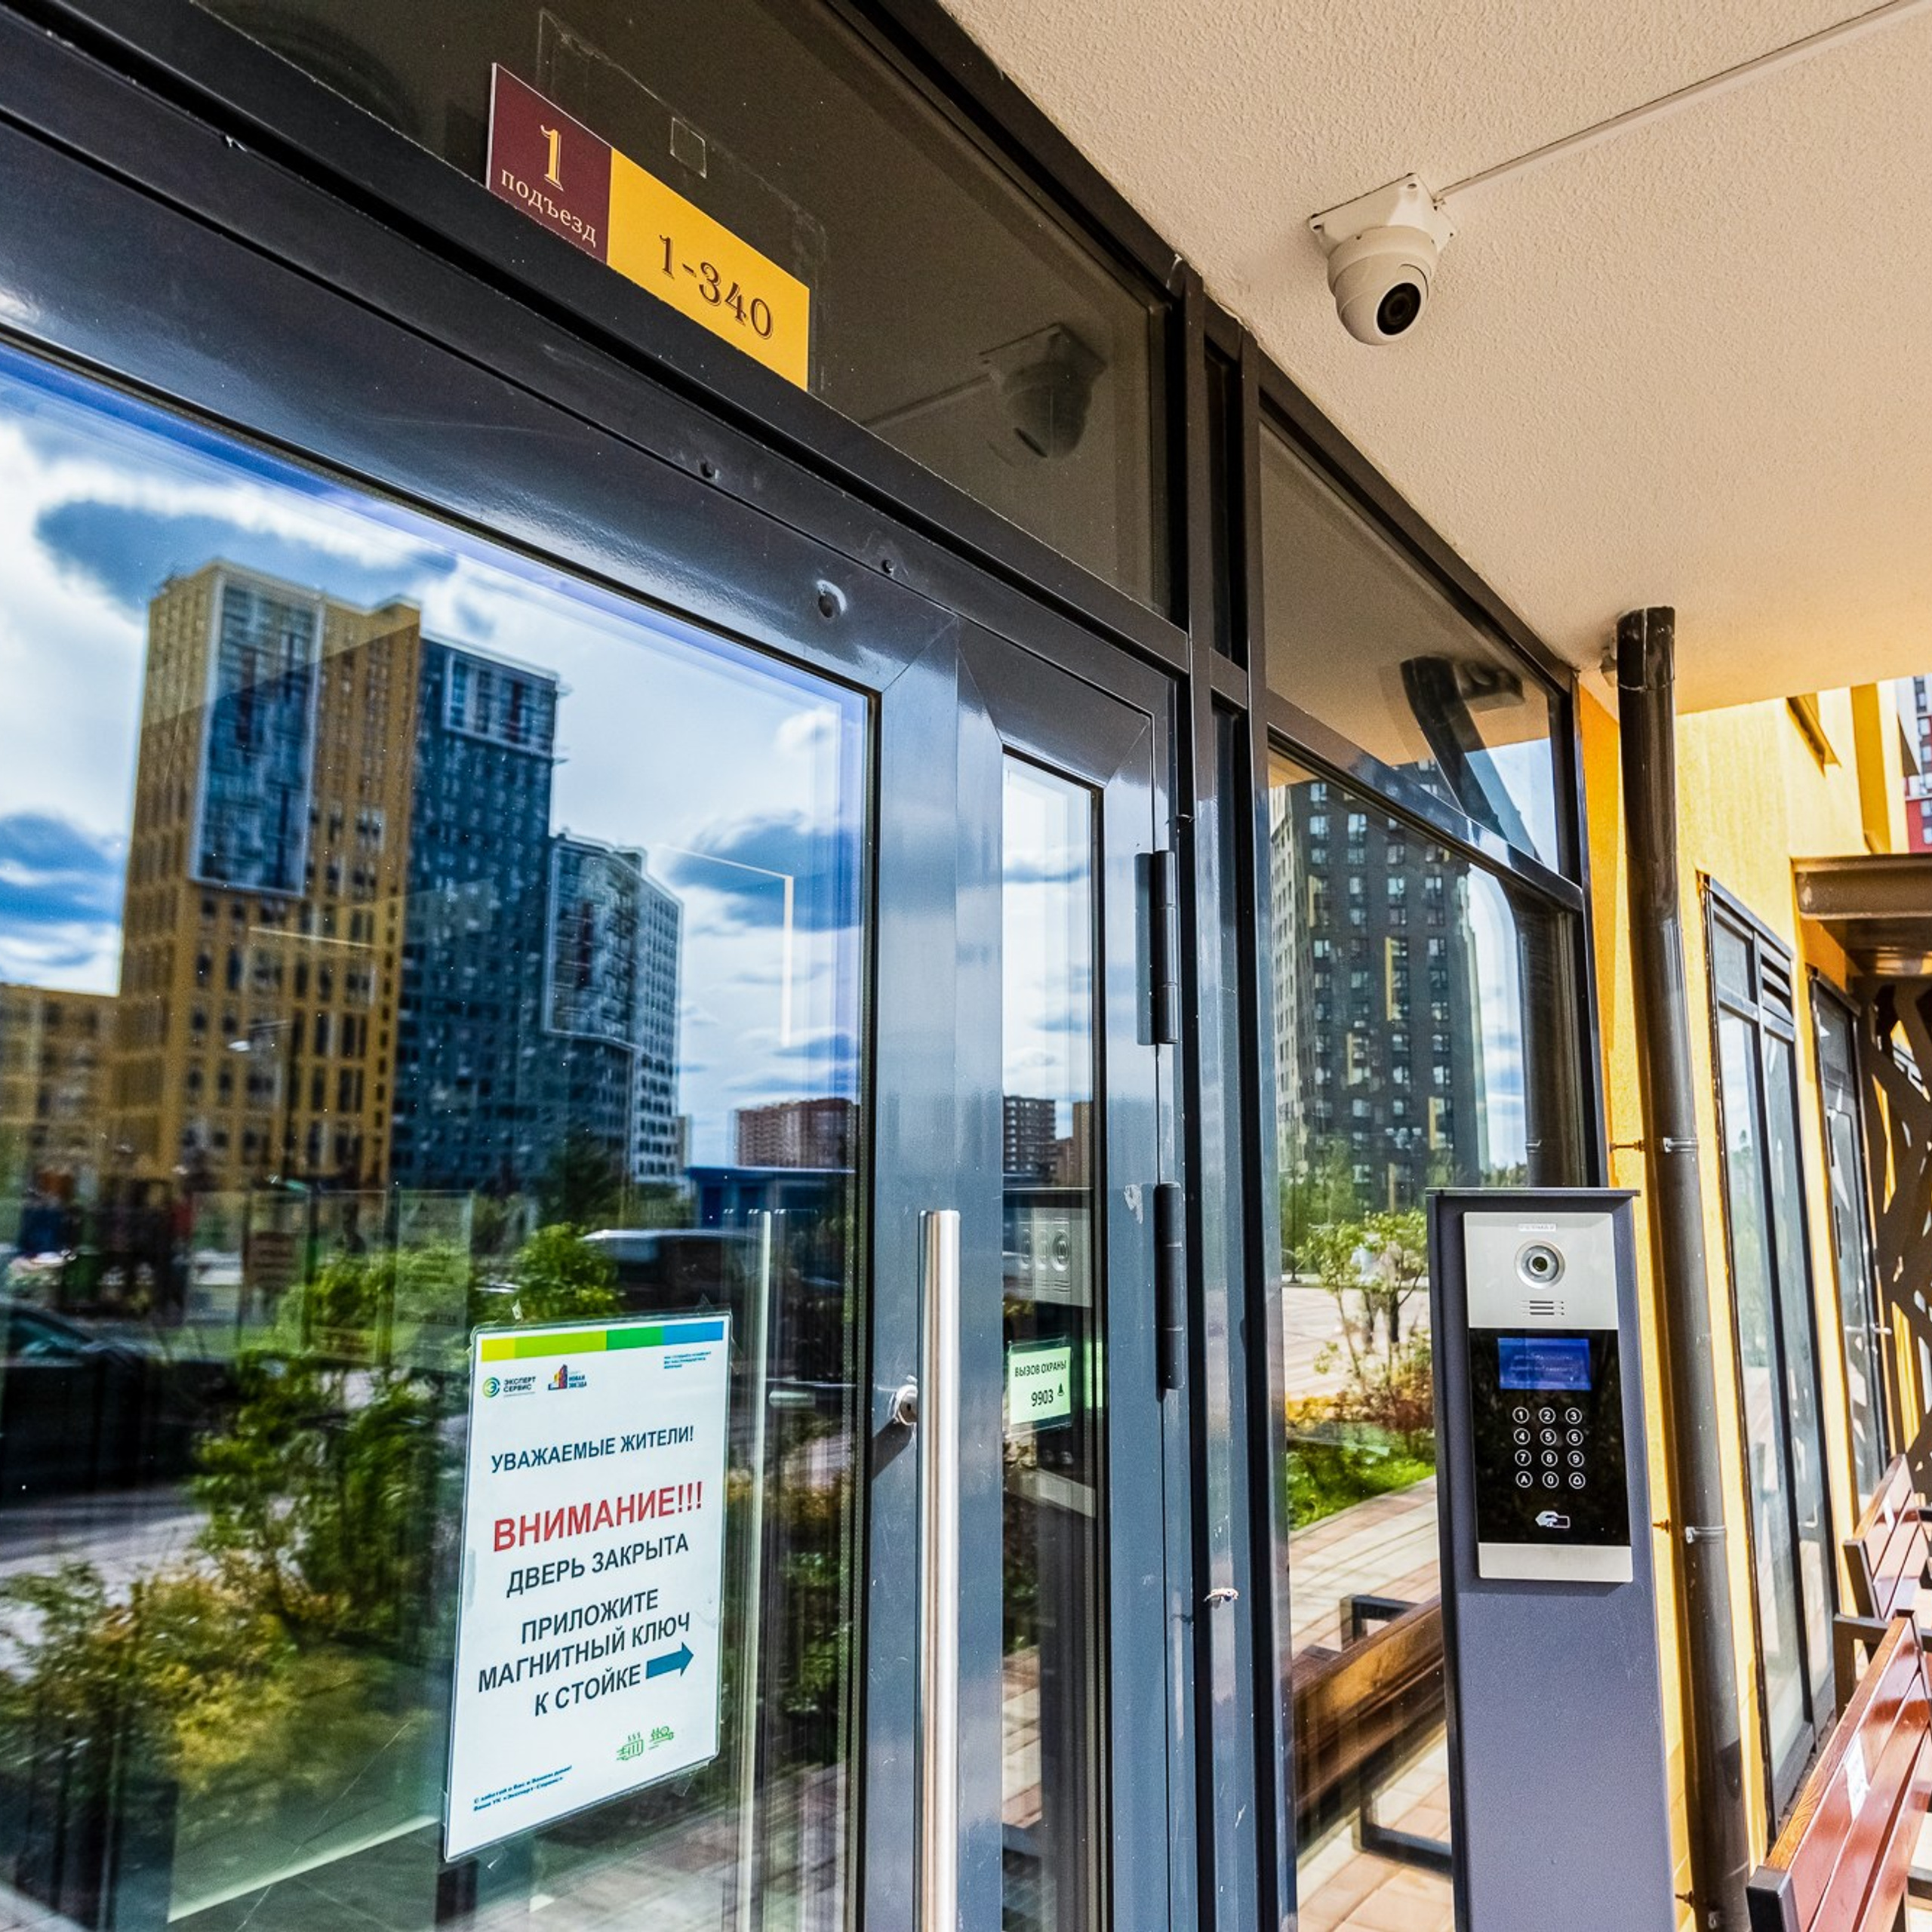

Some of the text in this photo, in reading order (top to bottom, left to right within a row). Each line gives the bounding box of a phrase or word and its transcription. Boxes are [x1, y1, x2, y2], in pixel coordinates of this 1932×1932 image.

[540, 124, 565, 192] 1
[500, 169, 598, 248] подъезд
[659, 234, 774, 340] 1-340
[503, 1383, 532, 1393] СЕРВИС
[504, 1376, 537, 1386] ЭКСПЕРТ
[1014, 1359, 1067, 1377] ВЫЗОВ ОХРАНЫ
[1031, 1389, 1054, 1407] 9903
[491, 1426, 694, 1473] УВАЖАЕМЫЕ ЖИТЕЛИ!
[494, 1481, 703, 1552] ВНИМАНИЕ!!!
[506, 1532, 689, 1598] ДВЕРЬ ЗАКРЫТА
[521, 1588, 659, 1644] ПРИЛОЖИТЕ
[478, 1612, 691, 1693] МАГНИТНЫЙ КЛЮЧ
[534, 1663, 641, 1717] К СТОЙКЕ
